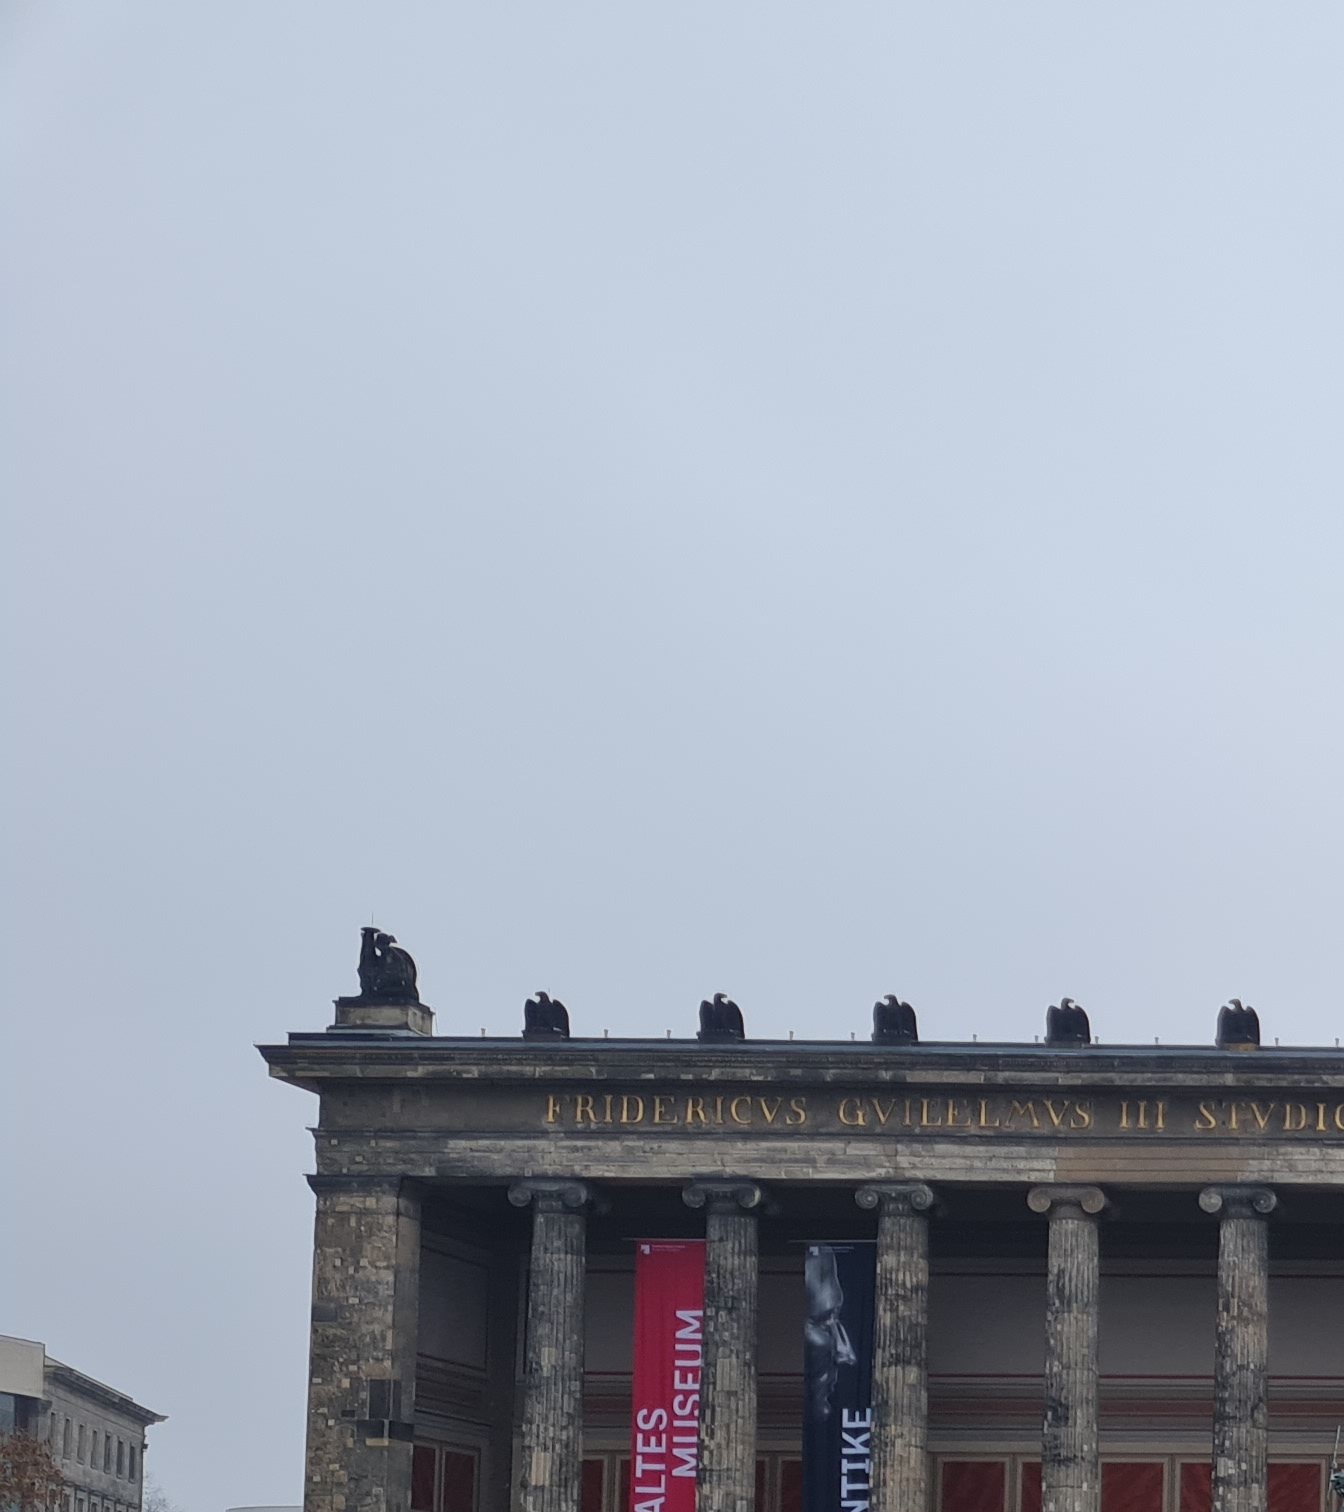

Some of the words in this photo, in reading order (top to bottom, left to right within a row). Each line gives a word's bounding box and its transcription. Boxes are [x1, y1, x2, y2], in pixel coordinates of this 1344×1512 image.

[545, 1095, 806, 1127] FRIDERICVS
[839, 1097, 1091, 1130] GVILELMVS
[1119, 1100, 1166, 1131] III
[672, 1309, 705, 1478] MUSEUM
